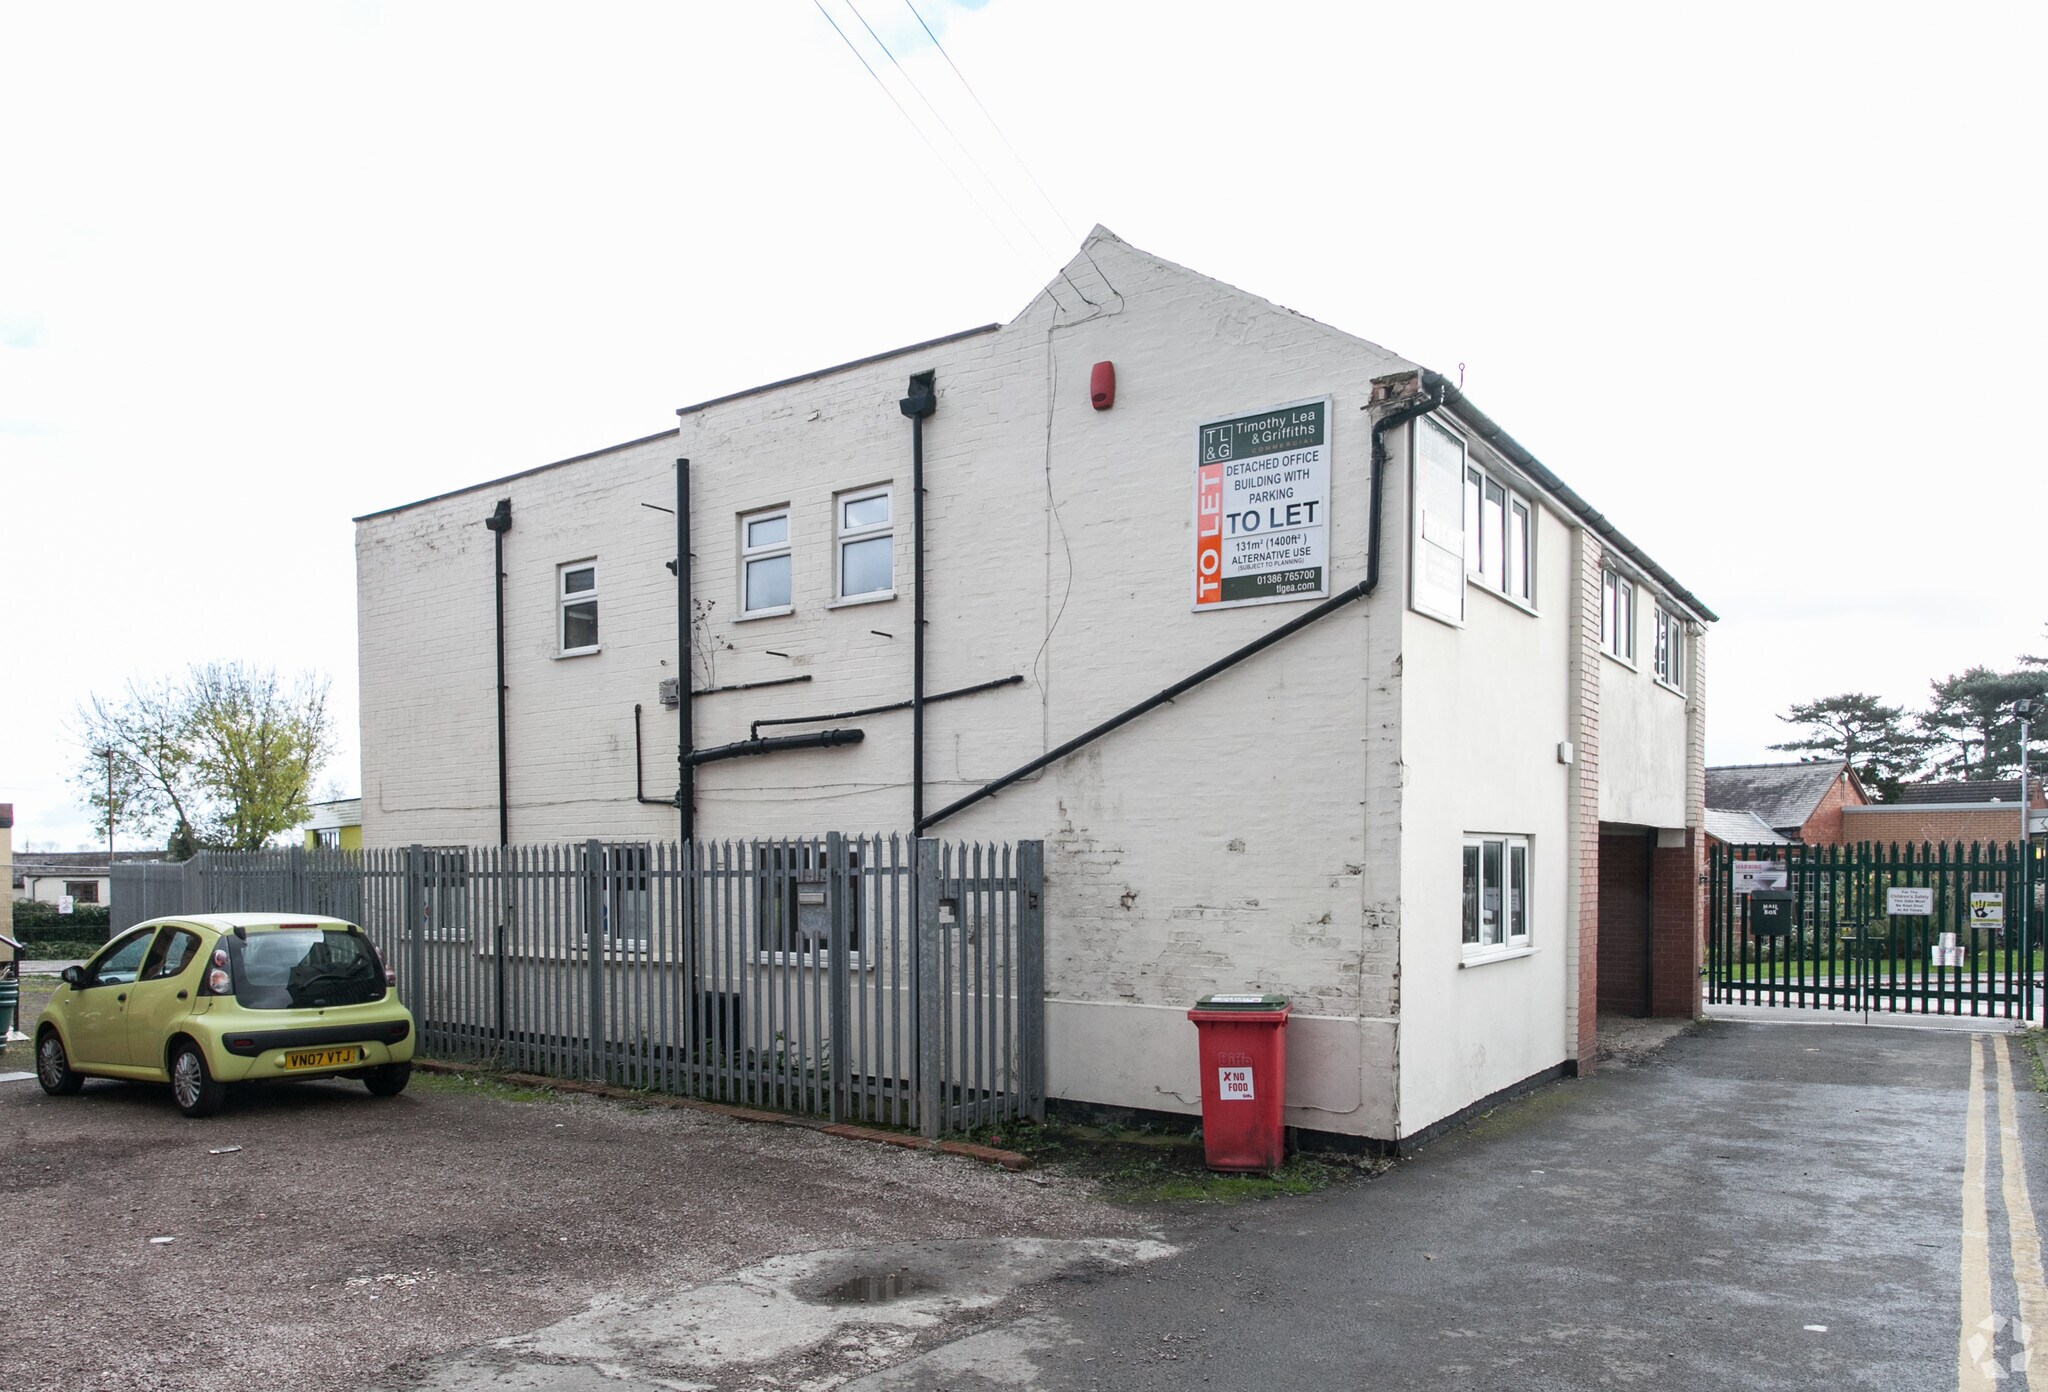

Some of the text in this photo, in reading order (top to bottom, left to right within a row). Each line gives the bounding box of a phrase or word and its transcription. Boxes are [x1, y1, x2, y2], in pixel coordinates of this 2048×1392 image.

[1236, 410, 1315, 434] Timothy Lea
[1262, 424, 1315, 443] Griffiths
[1251, 438, 1314, 454] COMMERCIAL
[1226, 450, 1319, 477] DETACHED OFFICE
[1234, 468, 1310, 491] BUILDING WITH
[1249, 487, 1294, 504] PARKING
[1226, 500, 1319, 535] TO LET
[1199, 471, 1220, 599] TO LET
[1231, 546, 1311, 565] ALTERNATIVE USE
[1238, 557, 1305, 572] (SUBJECT TO PLANNING)
[1256, 569, 1315, 586] 01386 765700
[291, 1050, 351, 1067] VN07 VTJ
[1233, 1072, 1245, 1081] NO
[1228, 1082, 1249, 1092] FOOD
